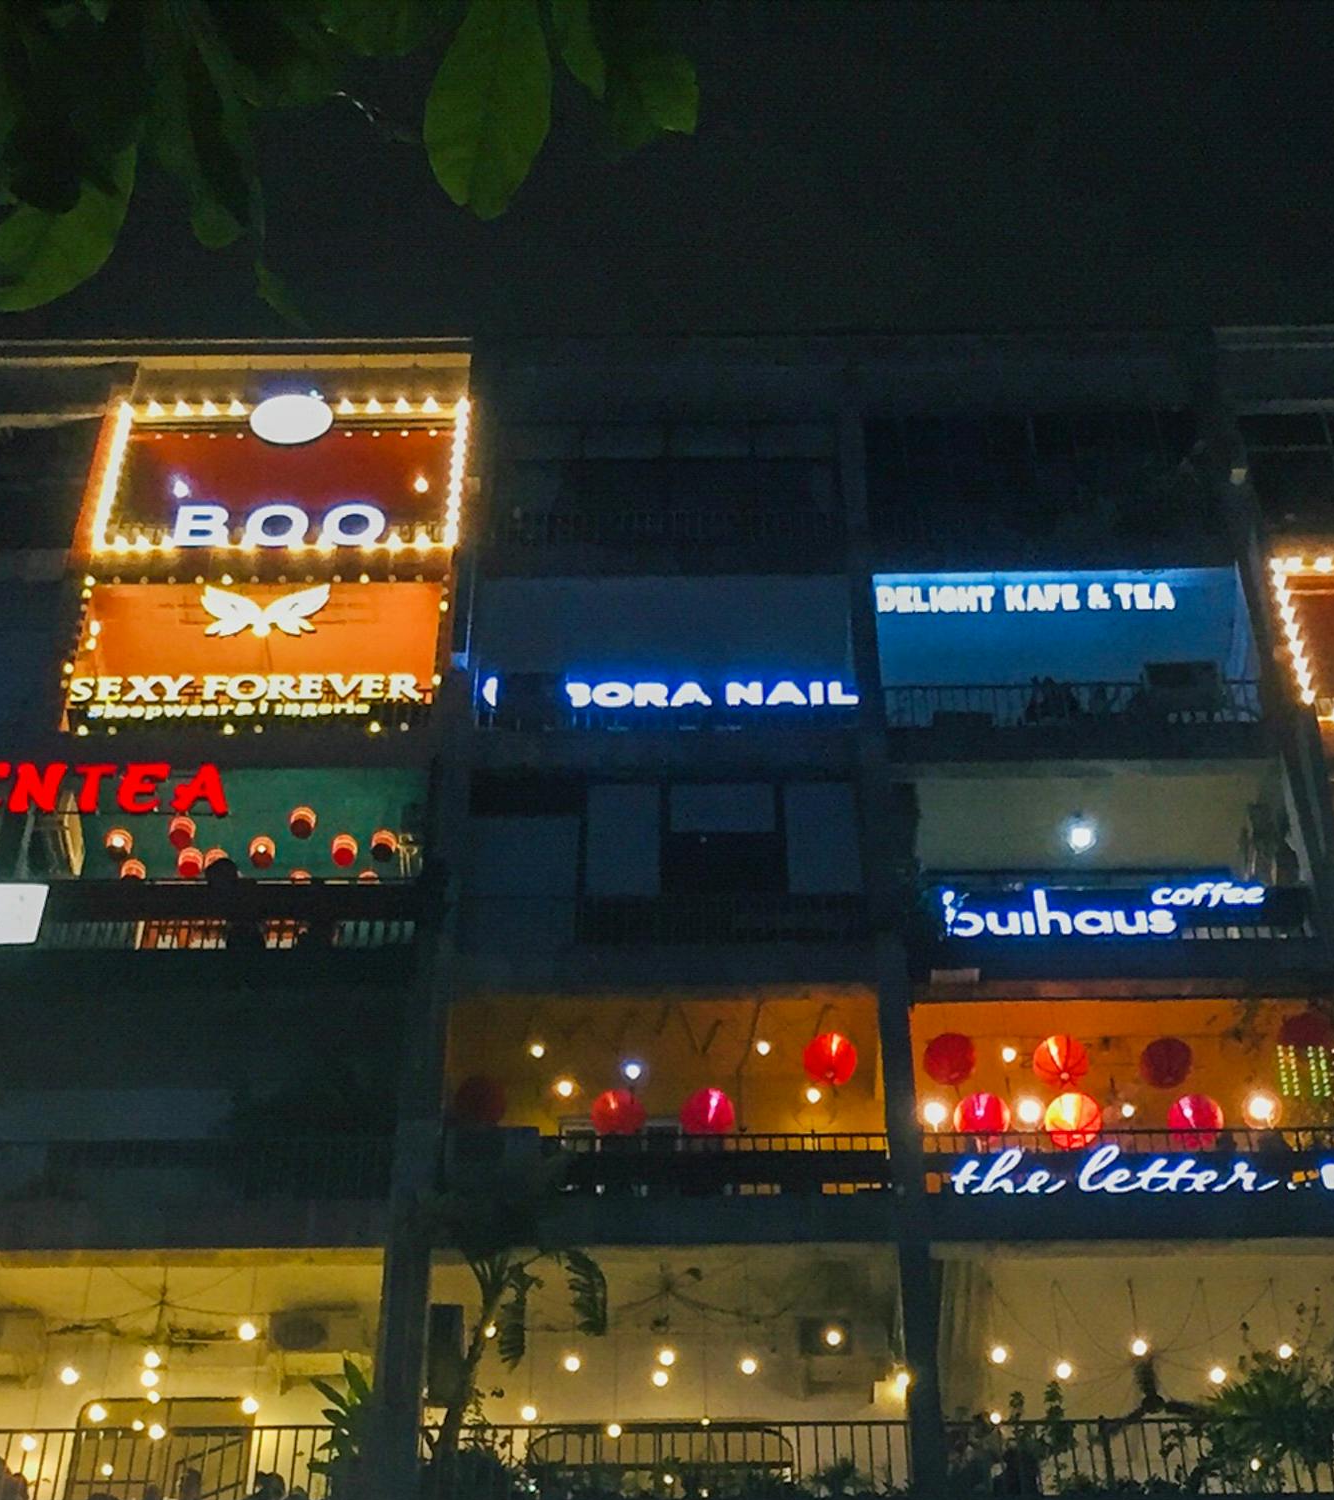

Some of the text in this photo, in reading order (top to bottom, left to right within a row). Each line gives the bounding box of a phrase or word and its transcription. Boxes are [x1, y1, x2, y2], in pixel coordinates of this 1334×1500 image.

[175, 504, 386, 548] BOO
[875, 585, 996, 613] DELIGHT
[1087, 582, 1112, 611] &
[1113, 582, 1177, 611] TEA
[68, 673, 424, 702] SEXY FOREVER
[724, 681, 860, 707] NAIL
[1151, 882, 1266, 907] coffee
[950, 1144, 1280, 1195] the letter
